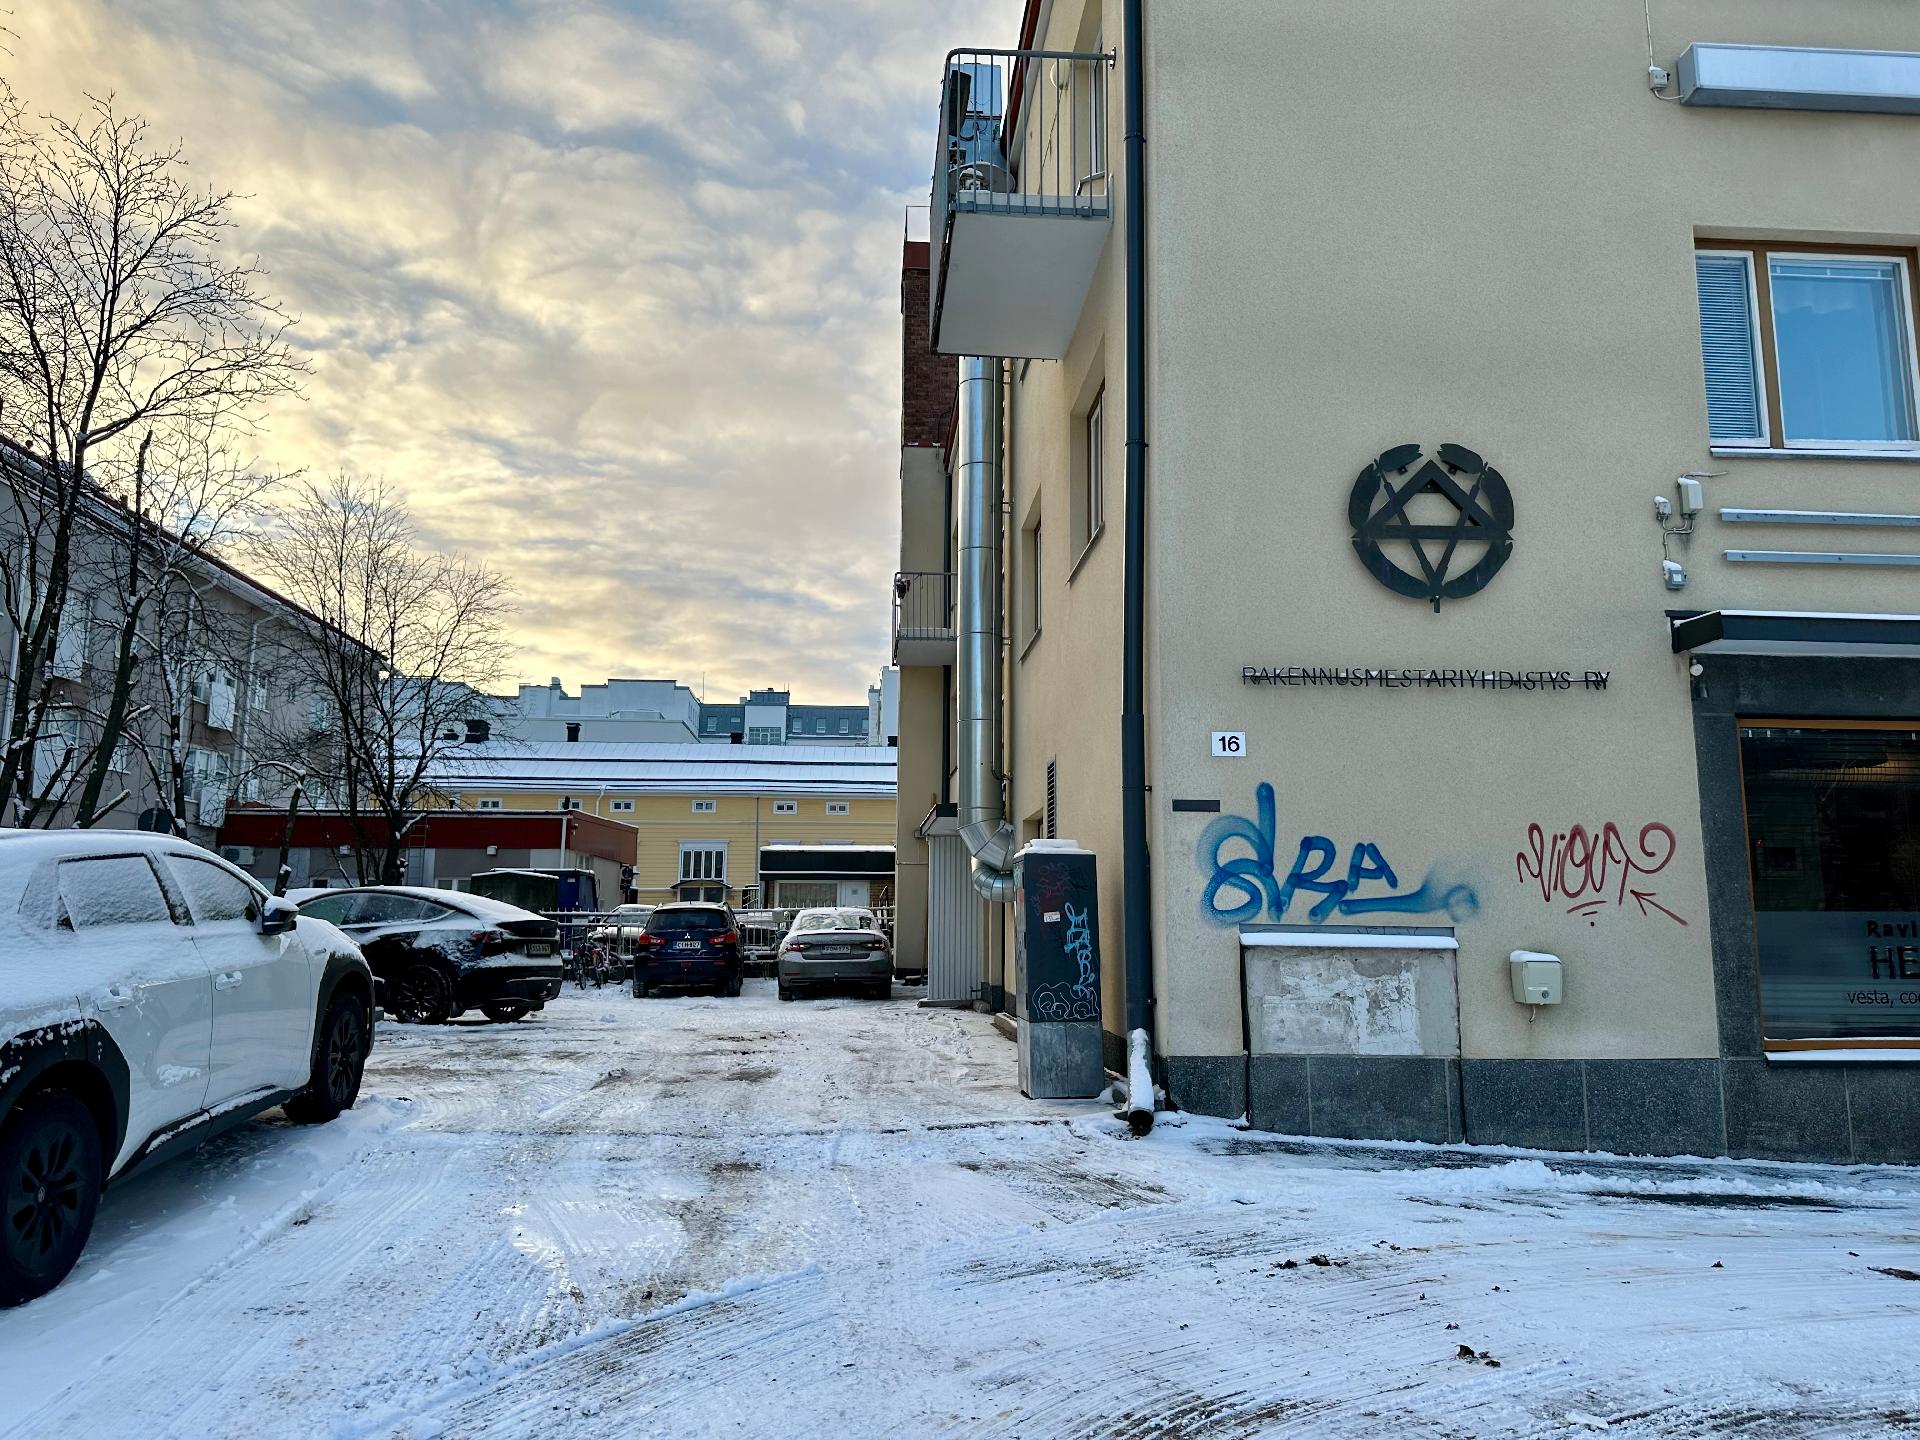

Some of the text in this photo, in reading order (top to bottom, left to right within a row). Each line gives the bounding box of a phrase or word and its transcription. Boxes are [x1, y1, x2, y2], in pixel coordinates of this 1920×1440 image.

[1242, 666, 1611, 691] RAKENNUSMESTARIYHDISTYS RY
[1218, 735, 1241, 752] 16
[1870, 945, 1920, 980] HE
[1847, 989, 1920, 1009] vesta, co
